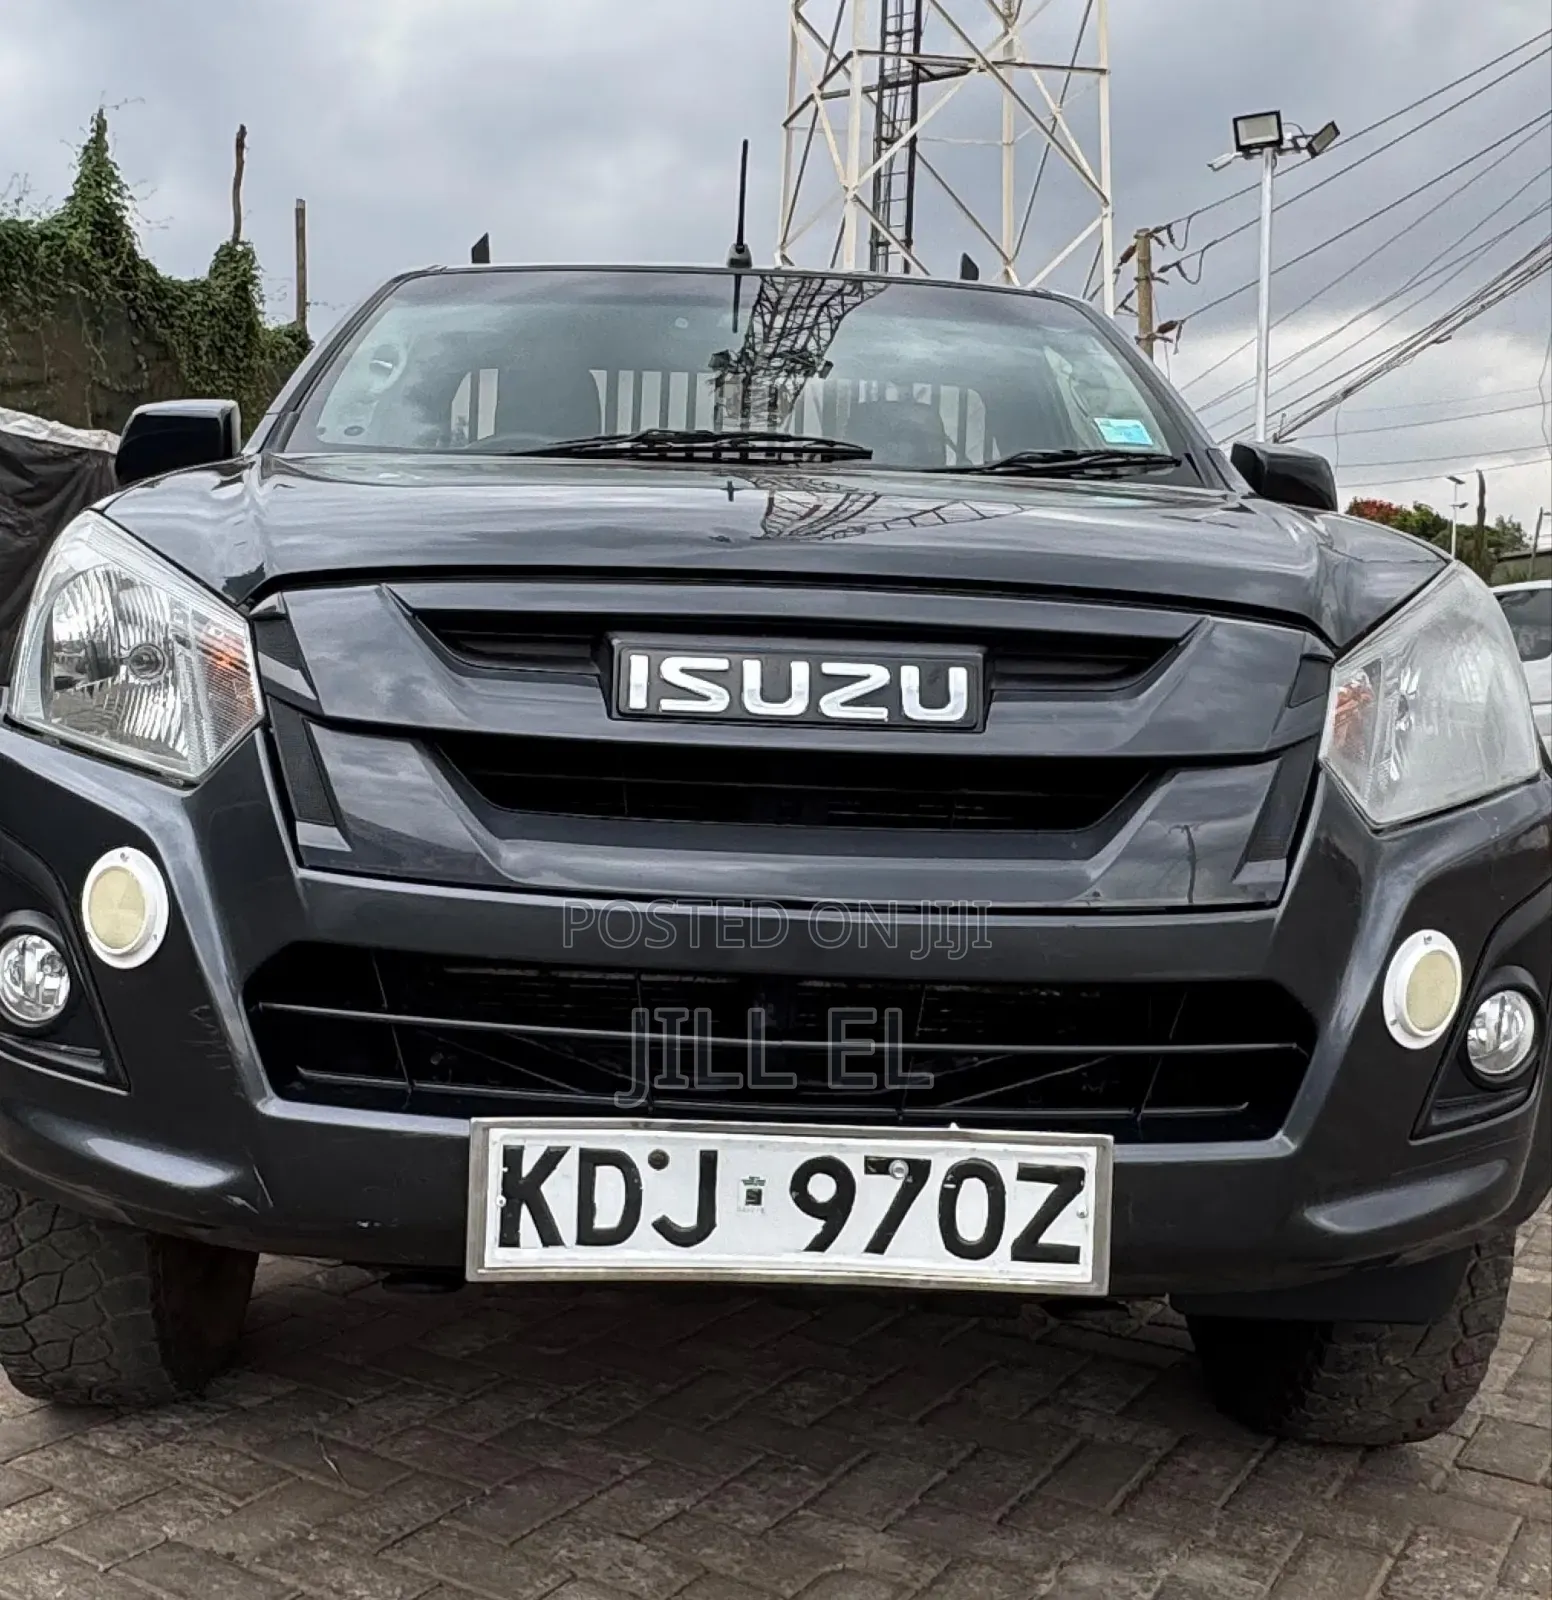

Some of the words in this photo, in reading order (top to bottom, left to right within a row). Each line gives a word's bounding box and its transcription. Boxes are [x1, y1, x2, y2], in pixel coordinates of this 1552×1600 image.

[629, 654, 967, 721] ISUZU
[498, 1145, 719, 1249] KDJ
[789, 1154, 1086, 1265] 970Z
